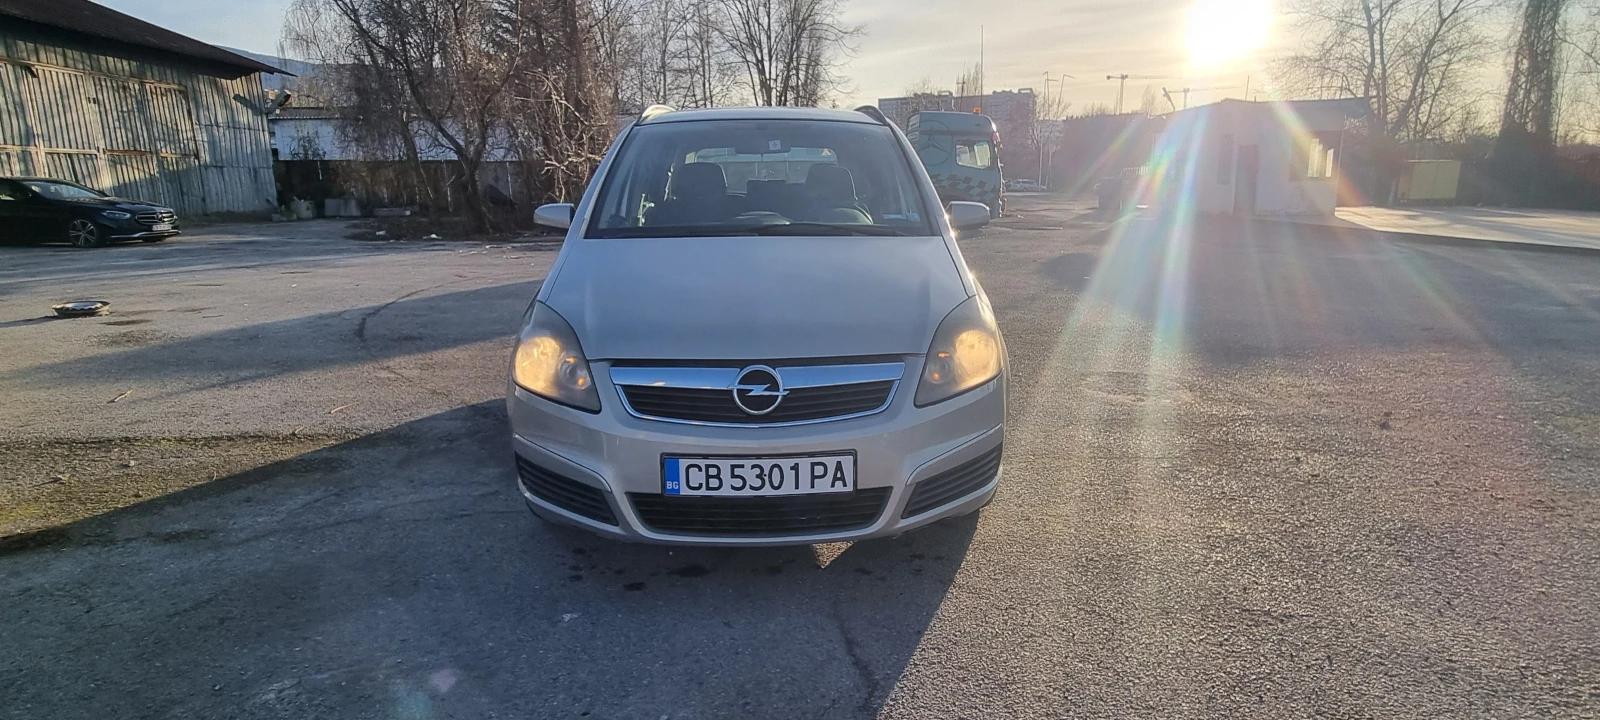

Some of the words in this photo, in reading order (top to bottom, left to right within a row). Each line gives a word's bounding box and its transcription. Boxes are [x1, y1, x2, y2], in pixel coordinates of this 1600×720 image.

[666, 481, 679, 490] BG
[685, 463, 723, 491] CB
[730, 462, 800, 491] 5301
[810, 461, 847, 489] PA
